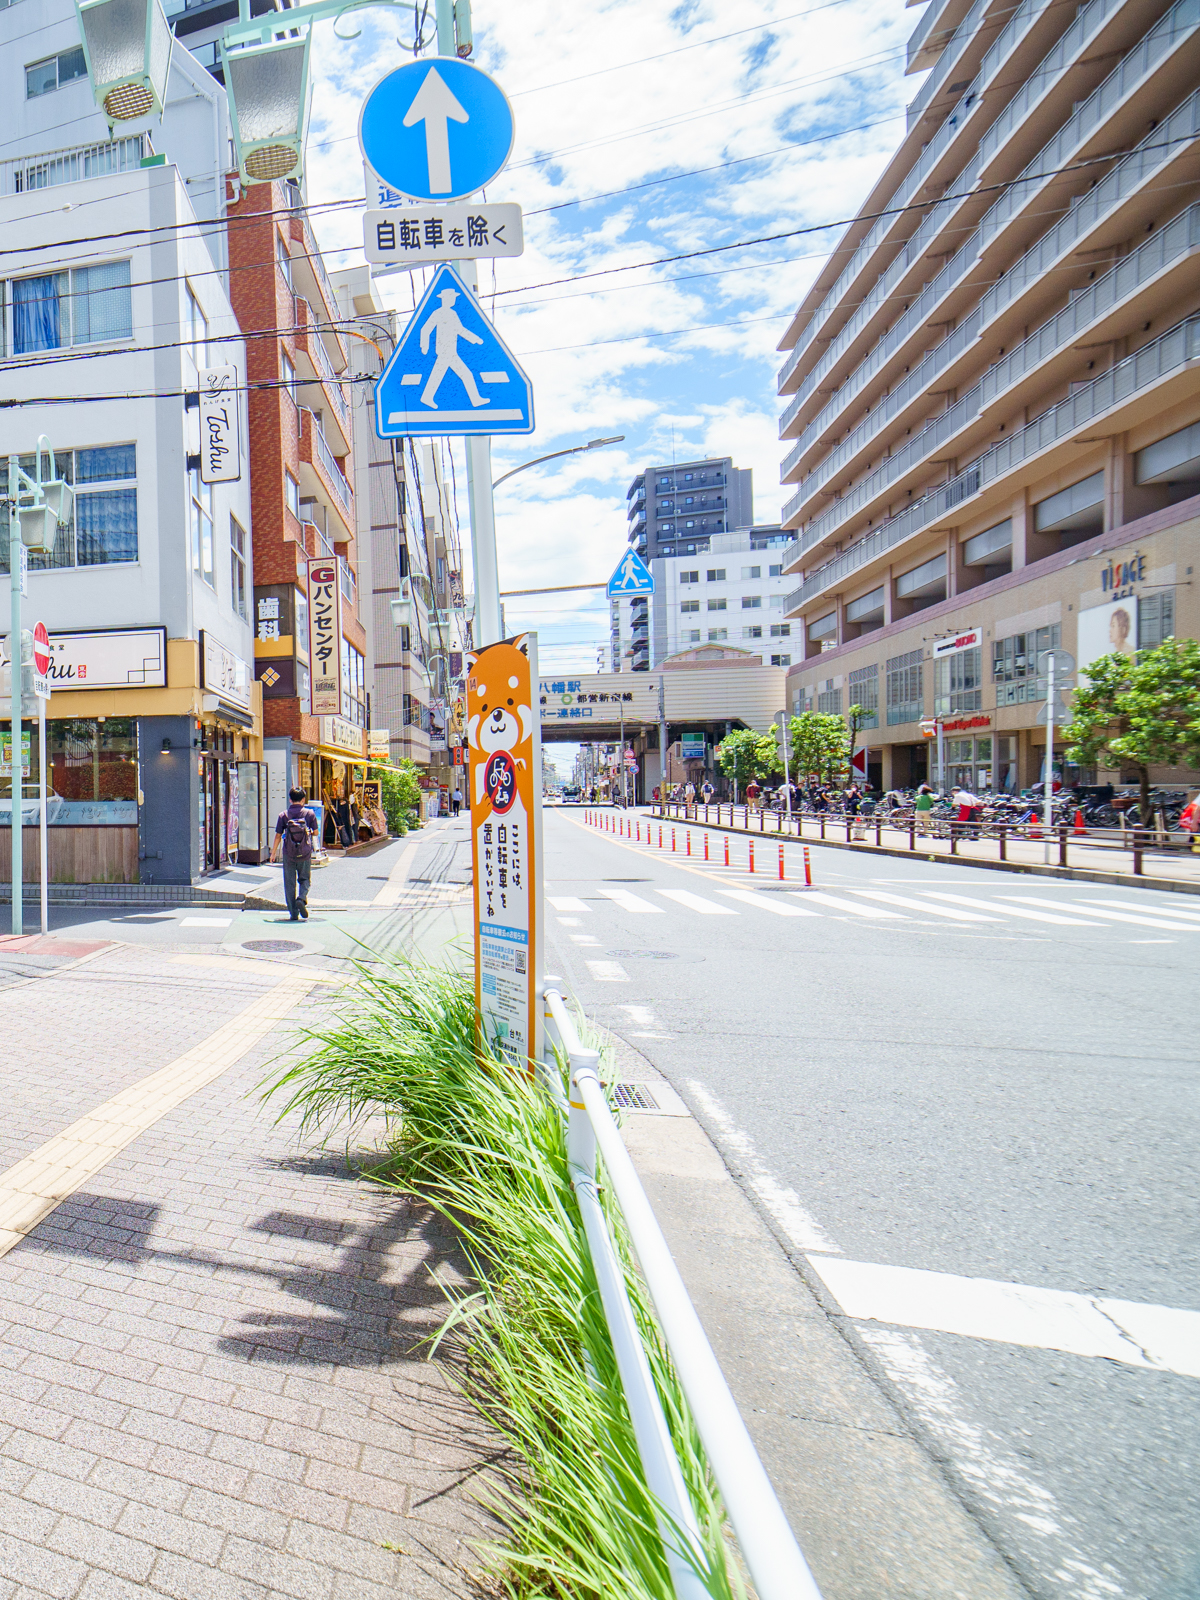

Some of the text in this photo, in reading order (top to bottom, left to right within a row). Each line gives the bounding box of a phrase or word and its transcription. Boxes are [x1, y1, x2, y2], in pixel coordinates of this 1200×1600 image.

[377, 215, 507, 250] 自転車を除く
[206, 407, 230, 474] Toshu
[257, 597, 280, 643] 歯科
[310, 567, 335, 675] Gパンセンター
[577, 692, 633, 703] 都営新宿線
[484, 823, 495, 917] 置かないでね
[497, 823, 507, 908] 自転車を
